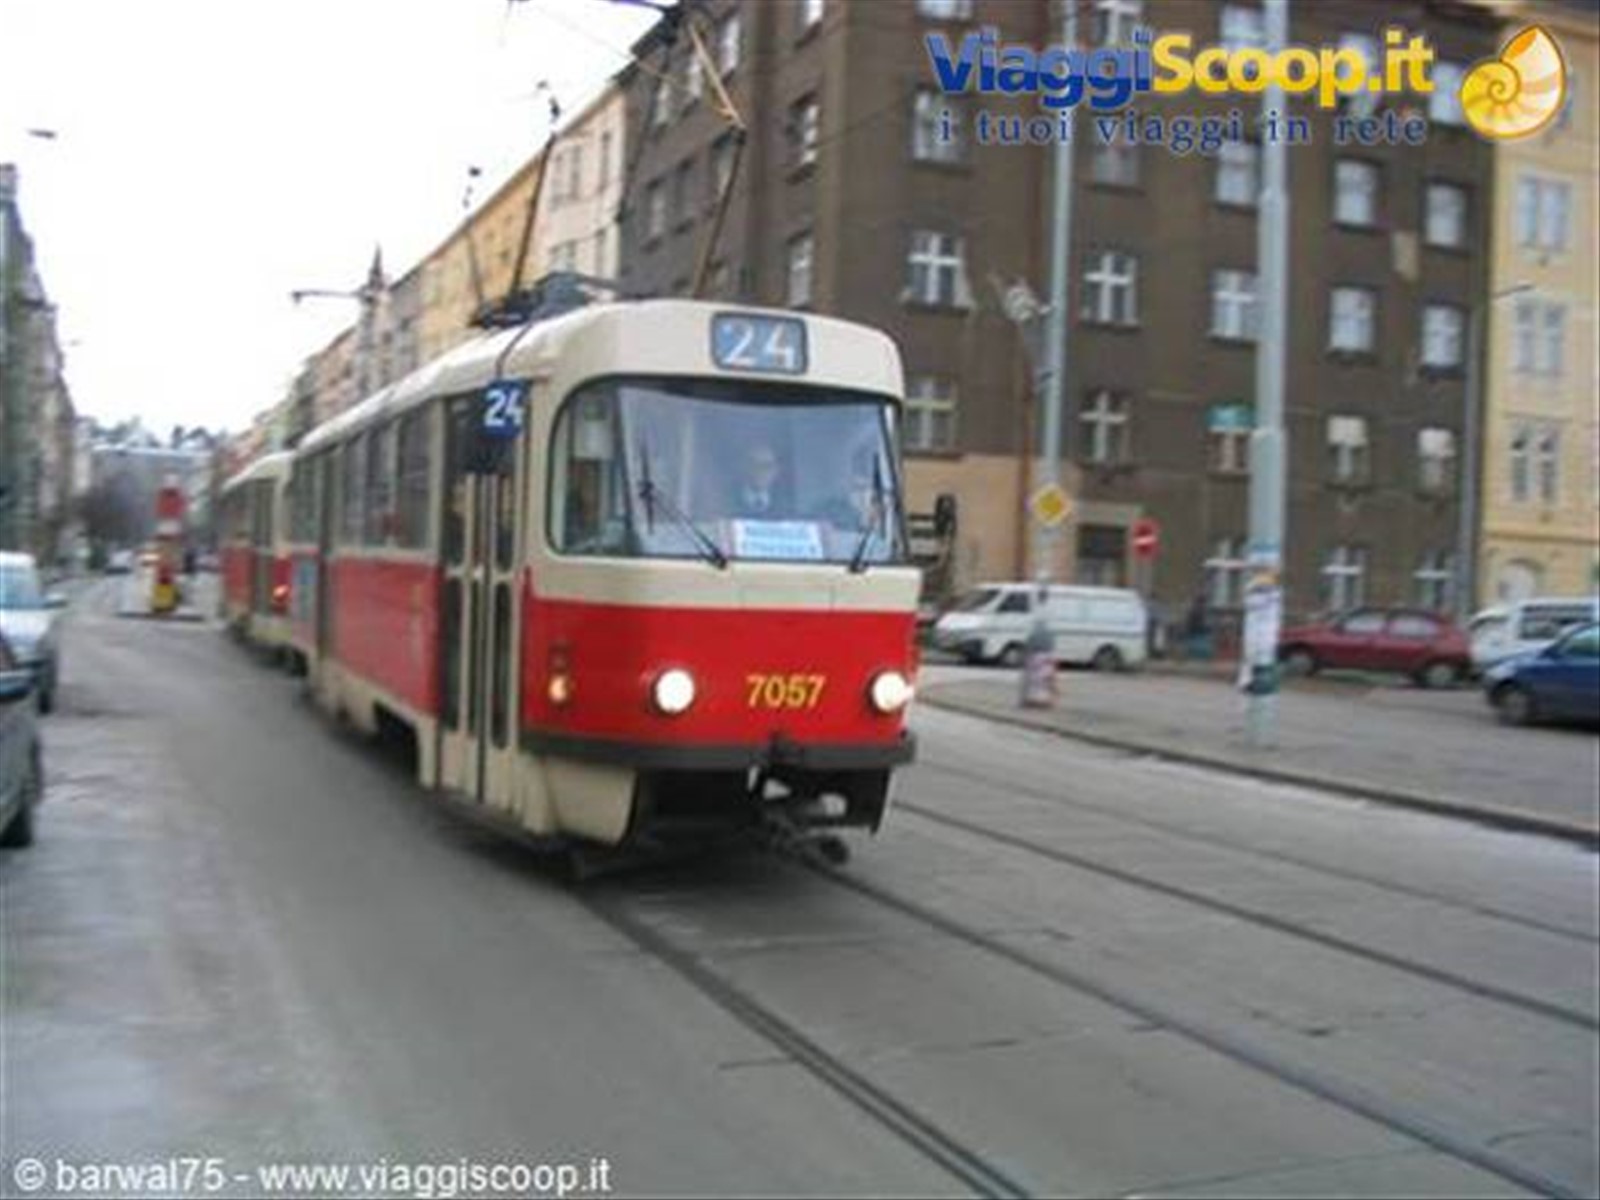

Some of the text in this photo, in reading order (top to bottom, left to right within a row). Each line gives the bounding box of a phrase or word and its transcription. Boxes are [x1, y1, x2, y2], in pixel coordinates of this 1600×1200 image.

[722, 319, 798, 370] 24
[484, 388, 524, 428] 24
[746, 674, 826, 707] 7057
